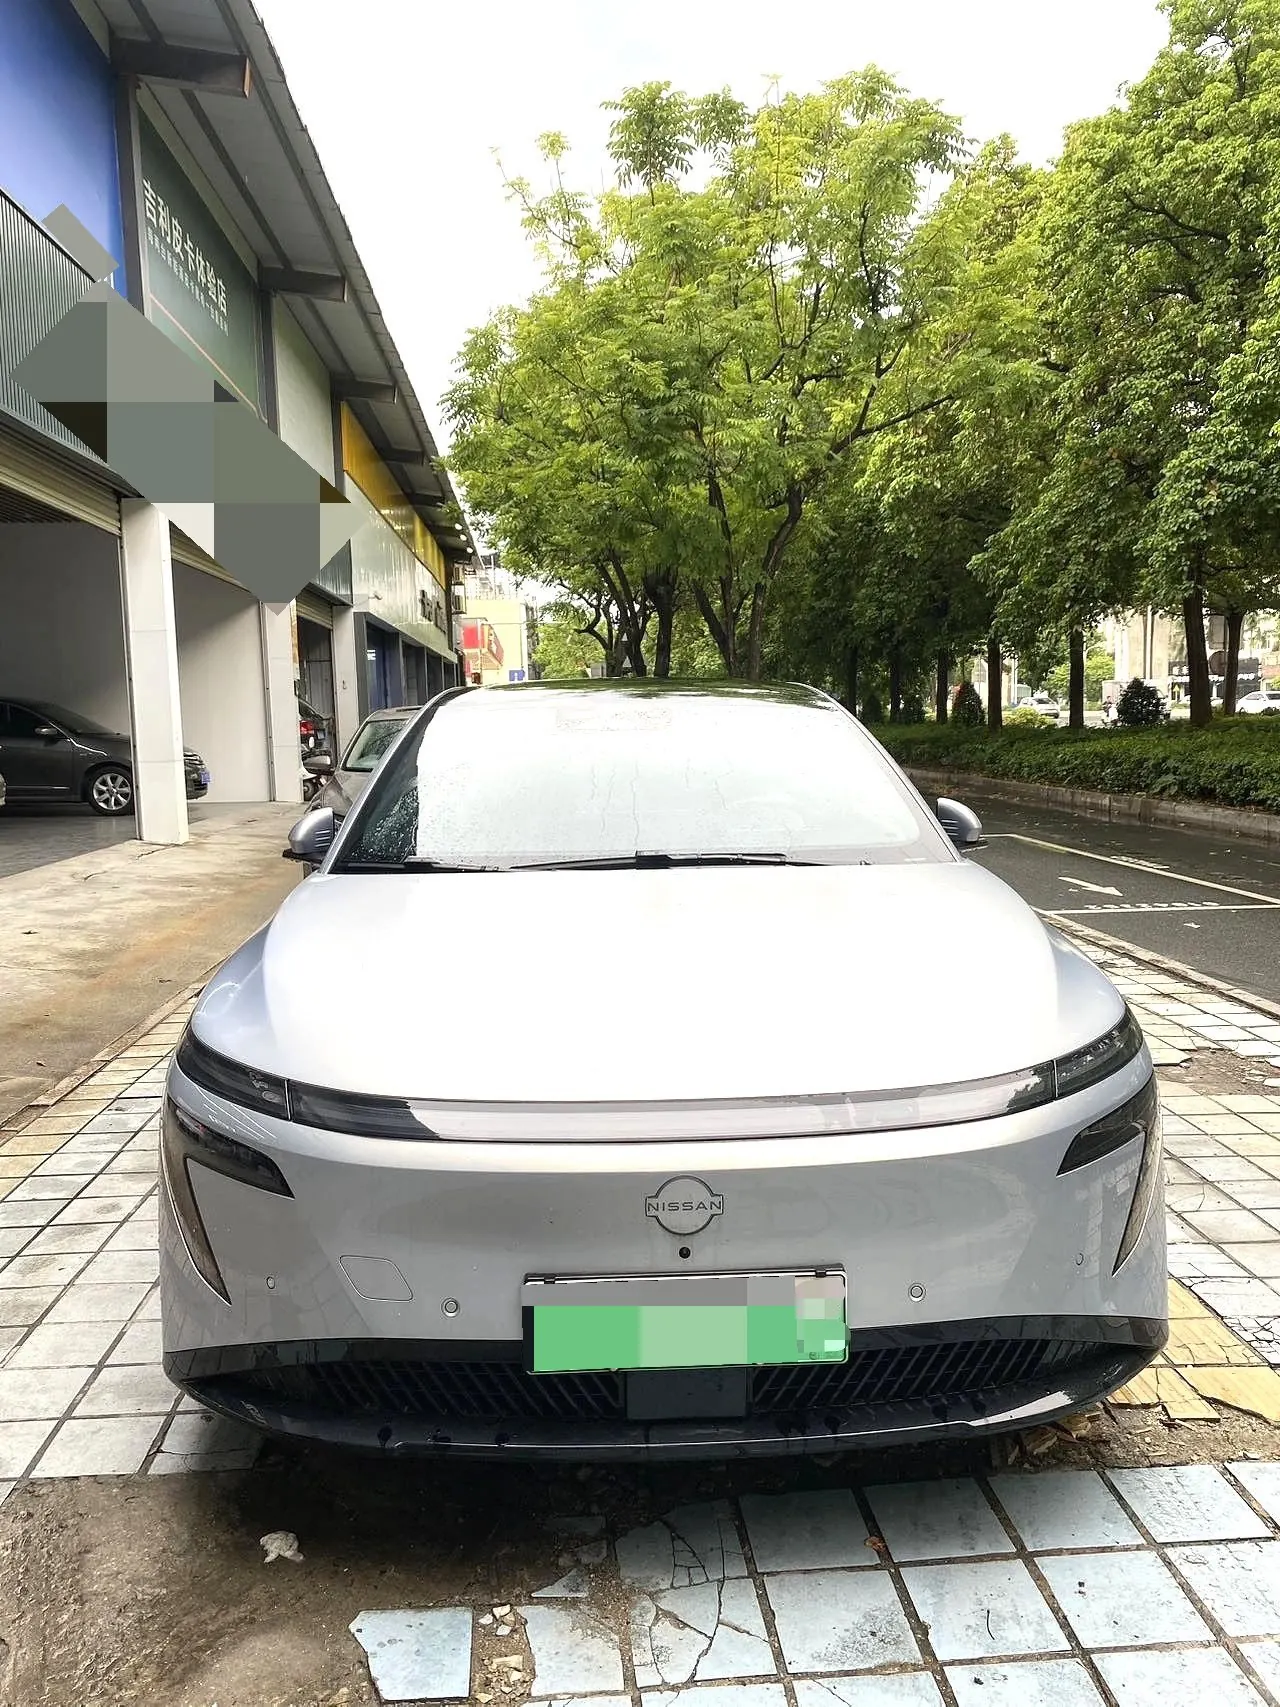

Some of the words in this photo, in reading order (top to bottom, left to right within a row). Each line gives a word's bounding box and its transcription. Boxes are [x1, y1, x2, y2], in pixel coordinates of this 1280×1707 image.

[143, 176, 227, 316] 吉利皮卡体验店
[647, 1200, 722, 1212] NISSAN
